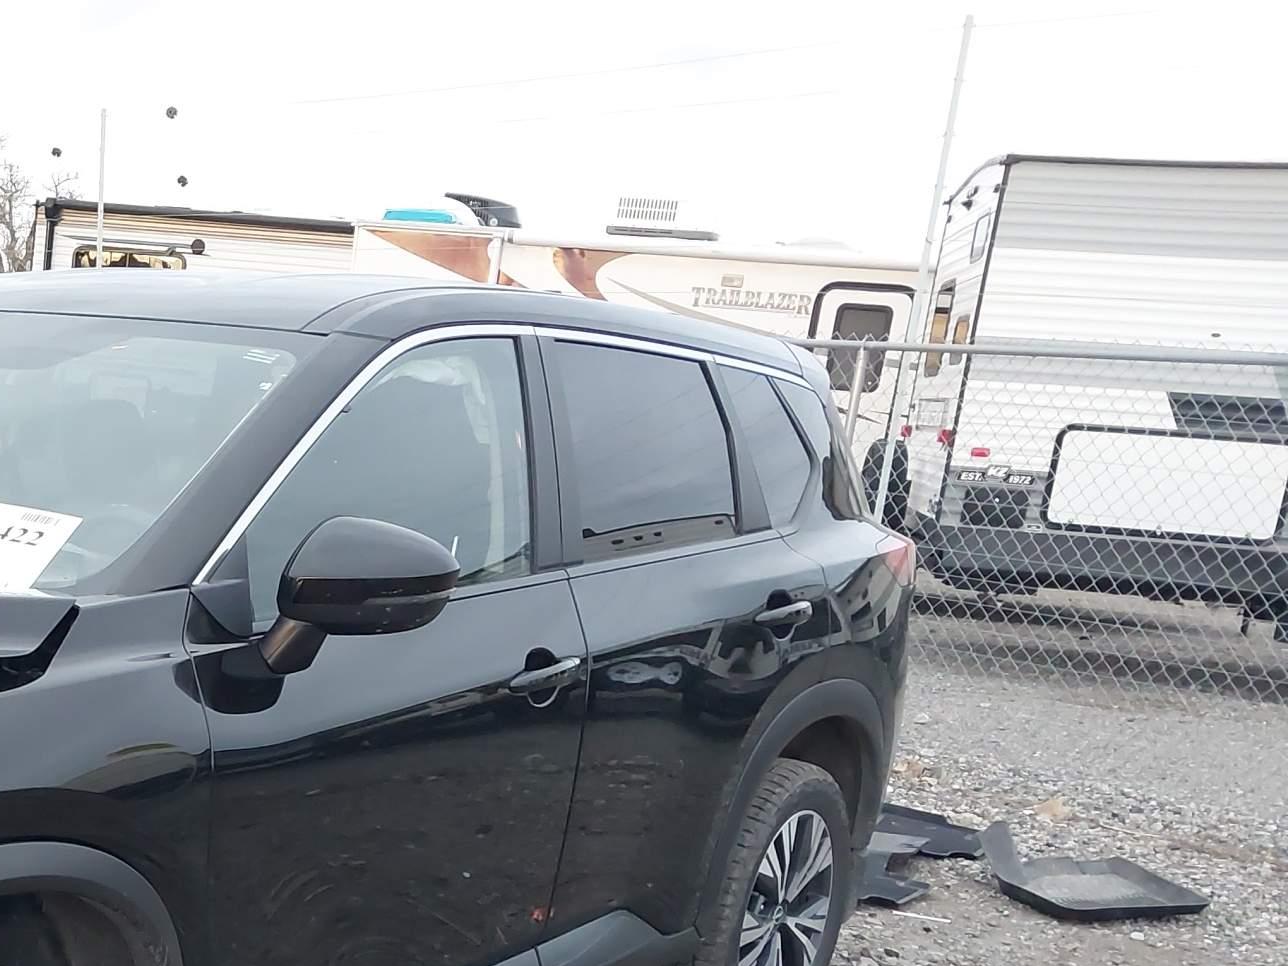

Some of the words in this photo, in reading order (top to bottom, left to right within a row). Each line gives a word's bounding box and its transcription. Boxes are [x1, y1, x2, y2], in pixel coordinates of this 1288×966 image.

[692, 287, 812, 315] TRAILBLAZER
[960, 471, 983, 481] EST.
[1008, 475, 1032, 485] 1972
